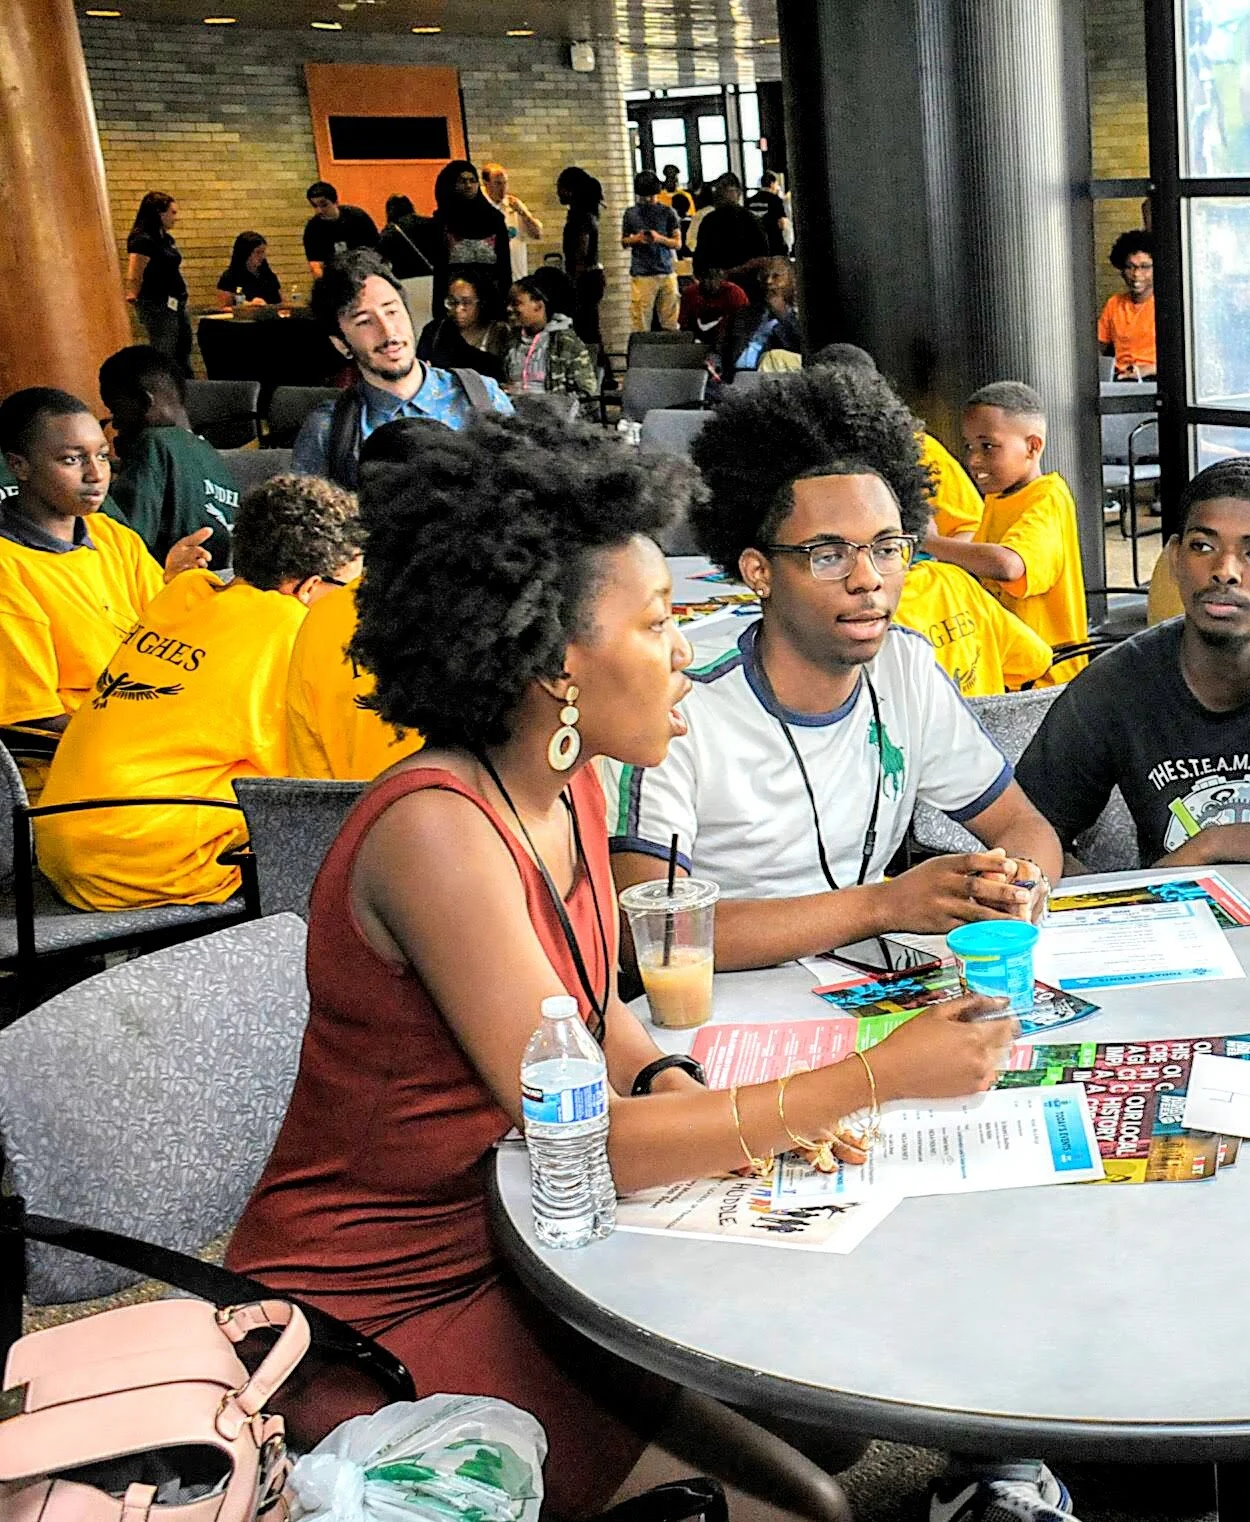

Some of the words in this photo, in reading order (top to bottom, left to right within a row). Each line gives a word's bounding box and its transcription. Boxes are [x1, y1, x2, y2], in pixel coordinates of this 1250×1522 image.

[1096, 1096, 1123, 1143] HISTORY
[1122, 1095, 1146, 1120] OUR
[1115, 1121, 1142, 1157] LOCAL
[718, 1182, 751, 1226] HUDDLE
